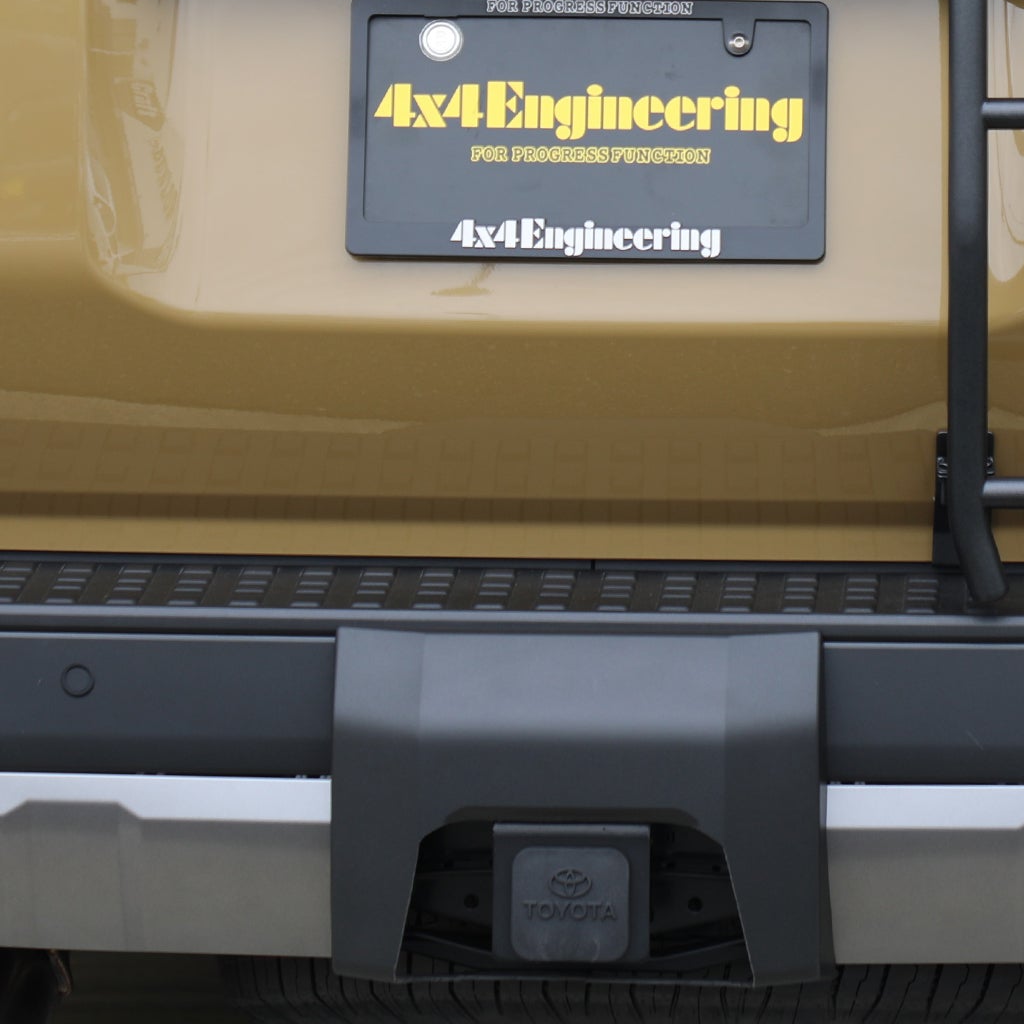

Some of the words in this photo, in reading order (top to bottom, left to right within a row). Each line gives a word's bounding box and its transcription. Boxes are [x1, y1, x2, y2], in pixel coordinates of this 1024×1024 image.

[487, 0, 518, 12] FOR
[521, 0, 606, 14] PROGRESS
[607, 0, 694, 15] FUNCTION
[374, 81, 804, 143] 4x4Engineering
[471, 145, 508, 162] FOR
[511, 146, 609, 163] PROGRESS
[611, 147, 711, 165] FUNCTION
[450, 218, 721, 258] 4x4Engineering
[523, 900, 617, 922] TOYOTA
